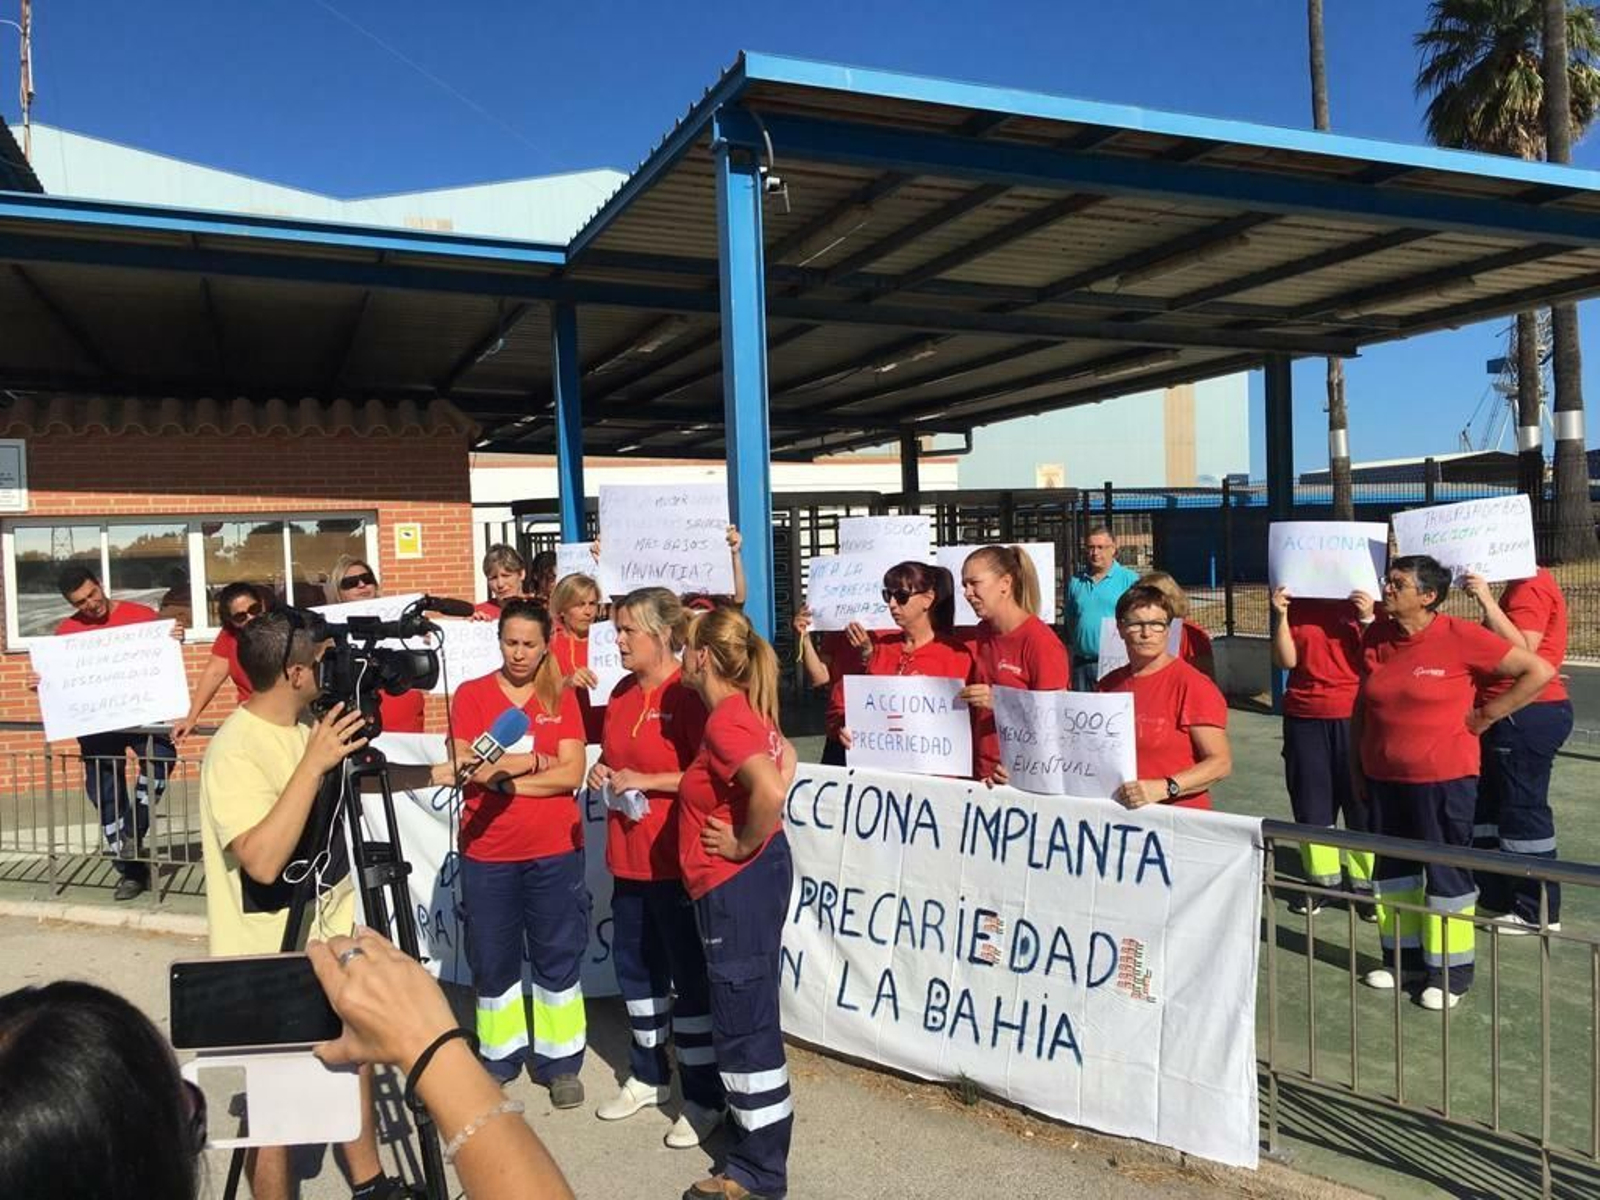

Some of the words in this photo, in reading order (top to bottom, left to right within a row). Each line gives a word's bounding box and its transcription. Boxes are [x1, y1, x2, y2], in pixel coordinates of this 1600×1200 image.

[1282, 535, 1367, 551] ACCIONA
[864, 693, 948, 715] ACCIONA
[1063, 708, 1124, 735] 500€
[851, 730, 953, 757] PRECARIEDAD
[1012, 753, 1097, 777] EVENTUAL
[783, 769, 940, 850] CCIONA
[960, 788, 1172, 887] IMPLANTA
[794, 875, 1119, 988] PRECARIEDAD
[778, 945, 804, 993] N
[837, 959, 900, 1022] LA
[923, 978, 1083, 1067] BAHIA
